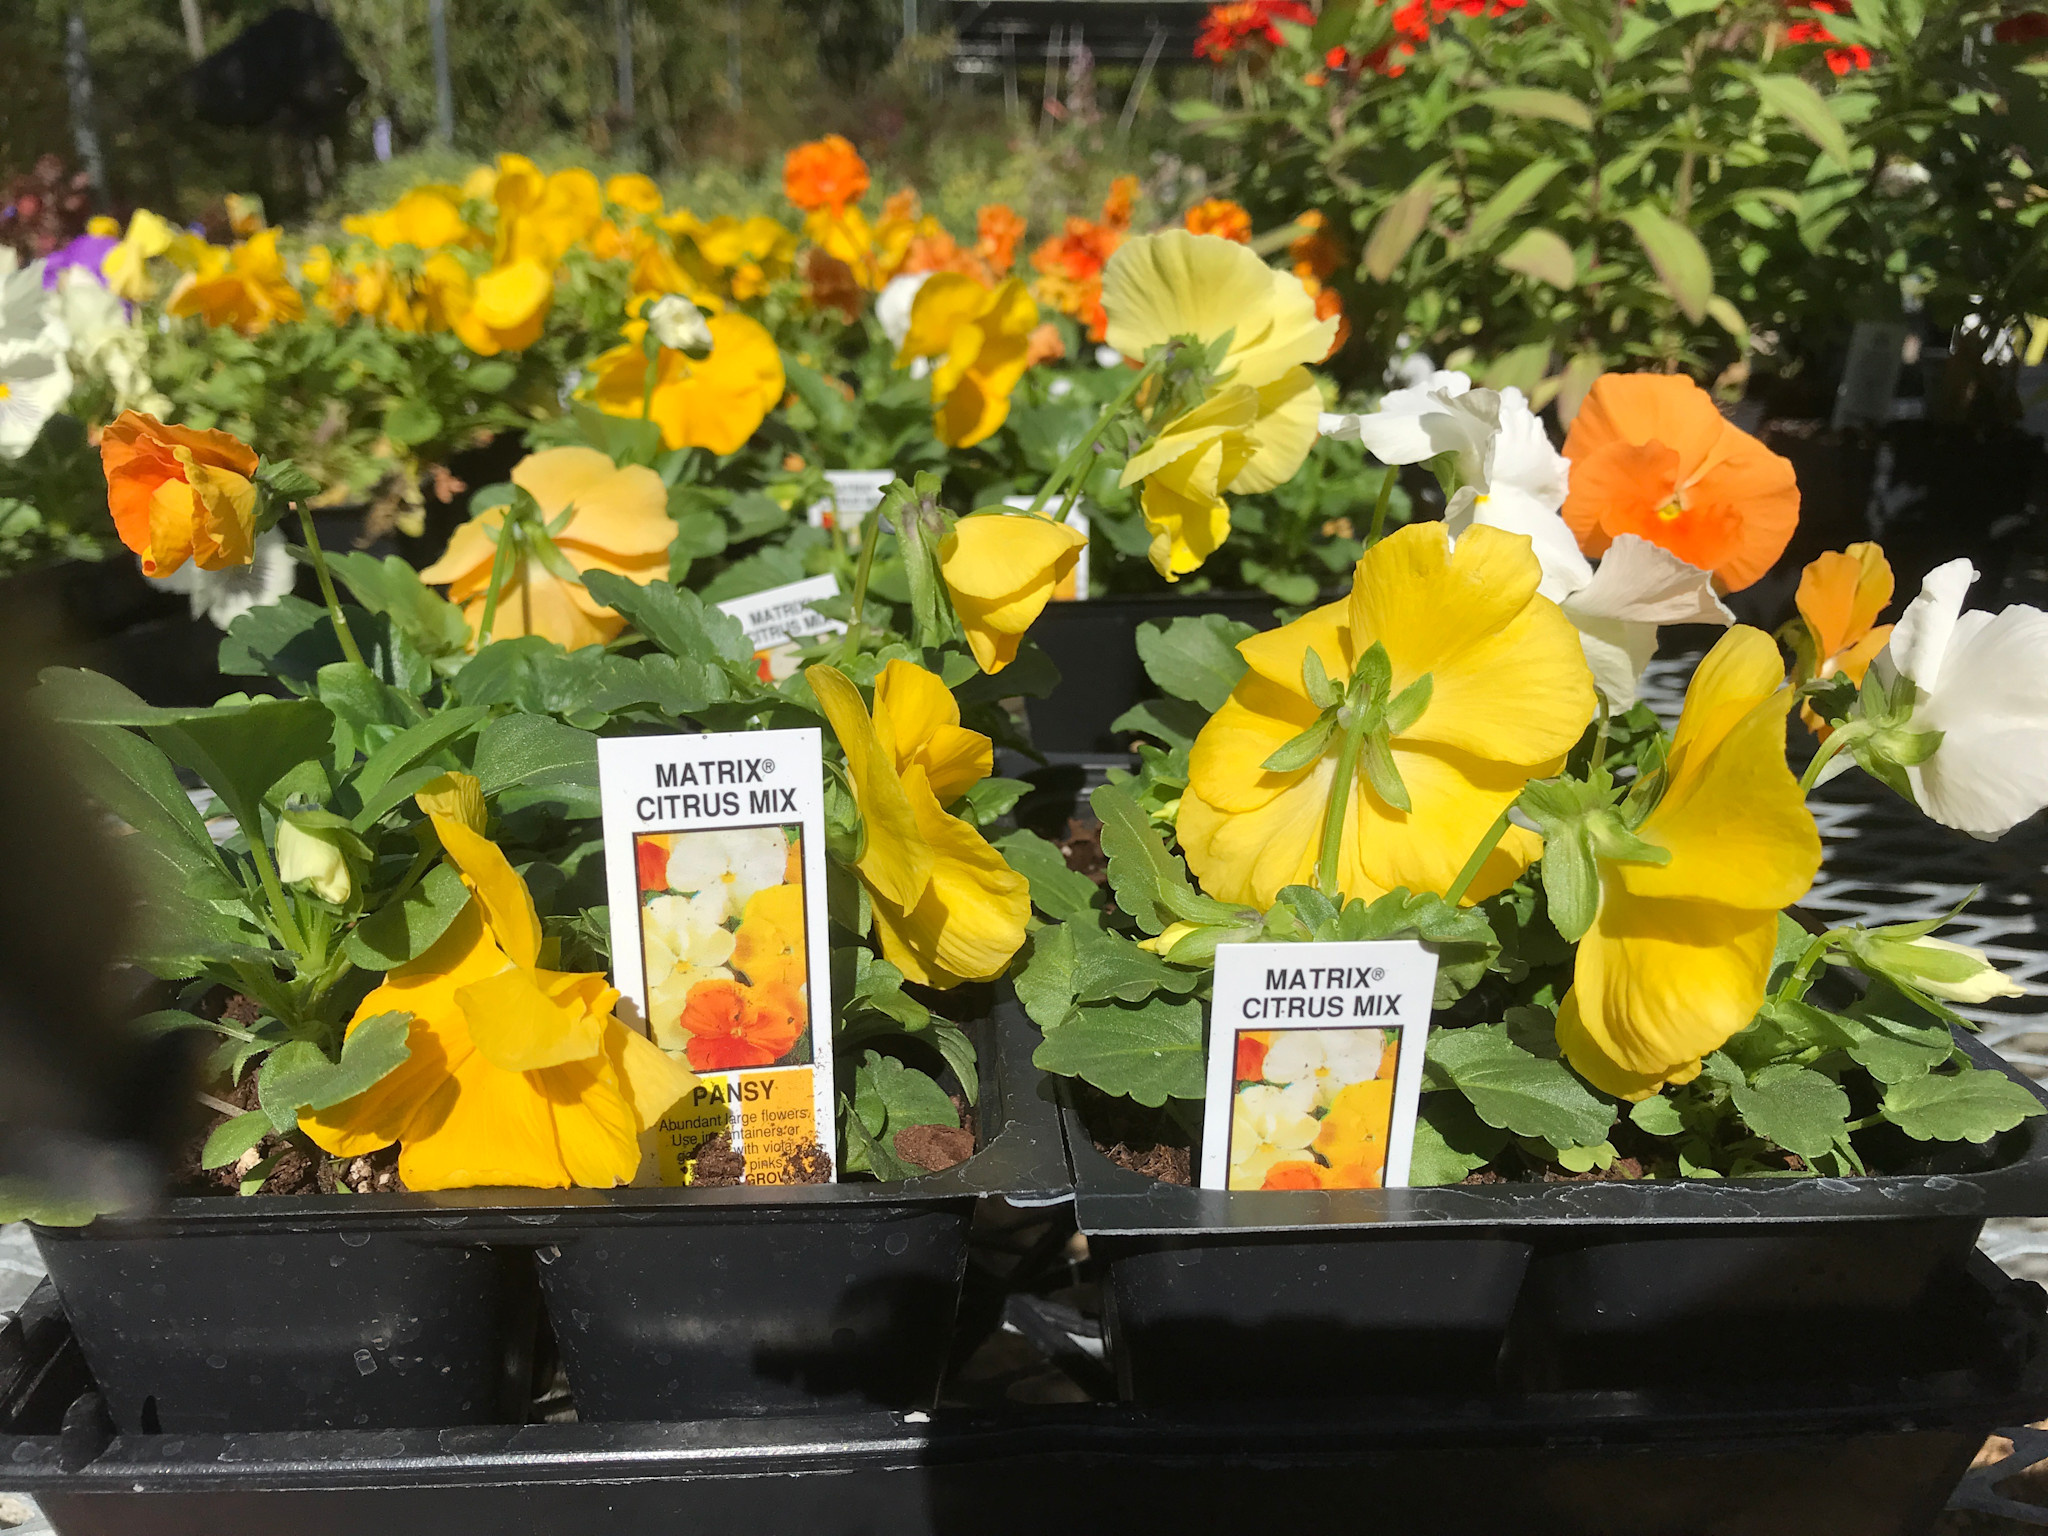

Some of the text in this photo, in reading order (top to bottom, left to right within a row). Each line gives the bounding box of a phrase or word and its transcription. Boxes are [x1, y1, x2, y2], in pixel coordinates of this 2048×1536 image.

[636, 787, 797, 821] CITRUS MIX
[1242, 994, 1403, 1019] CITRUS MIX
[693, 1079, 775, 1107] PANSY
[659, 1115, 722, 1132] Abundant
[724, 1111, 758, 1126] large
[672, 1133, 698, 1147] Use
[734, 1141, 759, 1155] with
